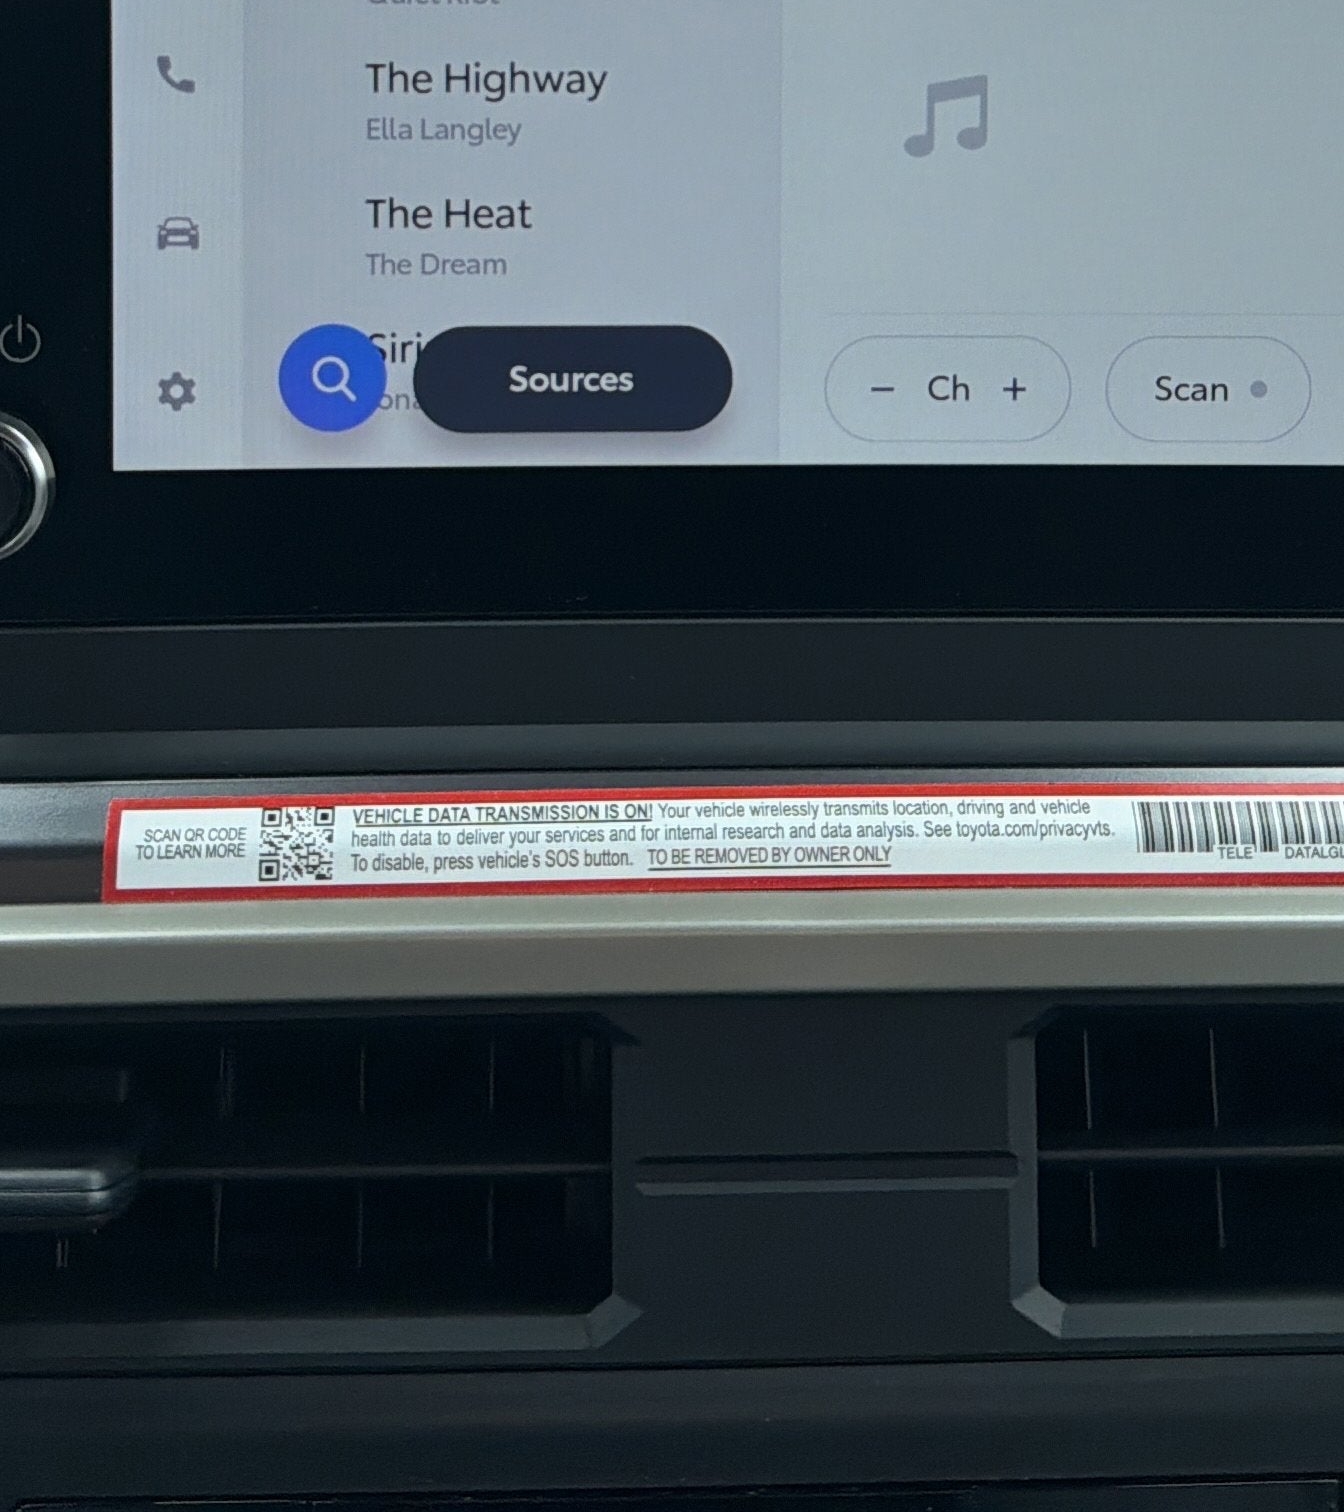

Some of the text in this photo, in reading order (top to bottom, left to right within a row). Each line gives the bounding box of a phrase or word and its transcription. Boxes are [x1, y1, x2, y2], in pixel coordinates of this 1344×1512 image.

[365, 61, 608, 103] The Highway
[366, 116, 522, 147] Ella Langley
[365, 196, 532, 230] The Heat
[365, 252, 507, 276] The Dream
[369, 331, 422, 363] Siri
[509, 365, 634, 393] Sources
[927, 373, 970, 402] Ch
[1155, 375, 1228, 402] Scan
[353, 799, 1091, 824] VEHICLE DATA TRANSMISSION IS ON! Your vehicle wirelessly transmits location, driving and vehicle
[144, 827, 247, 843] SCAN QR CODE
[351, 831, 395, 847] health
[400, 830, 432, 846] data
[437, 830, 451, 846] to
[456, 828, 505, 846] deliver
[508, 832, 541, 849] your
[545, 828, 604, 844] services
[609, 825, 636, 842] and
[641, 825, 660, 841] for
[664, 823, 717, 840] internal
[722, 822, 785, 839] research
[789, 822, 816, 838] and
[820, 822, 852, 838] data
[856, 821, 919, 842] analysis.
[923, 820, 952, 838] See
[136, 843, 246, 860] TO LEARN MORE
[351, 845, 892, 874] To disable, press vehicle's SOS button. TO BE REMOVED BY OWNER ONLY
[1217, 846, 1253, 860] TELE
